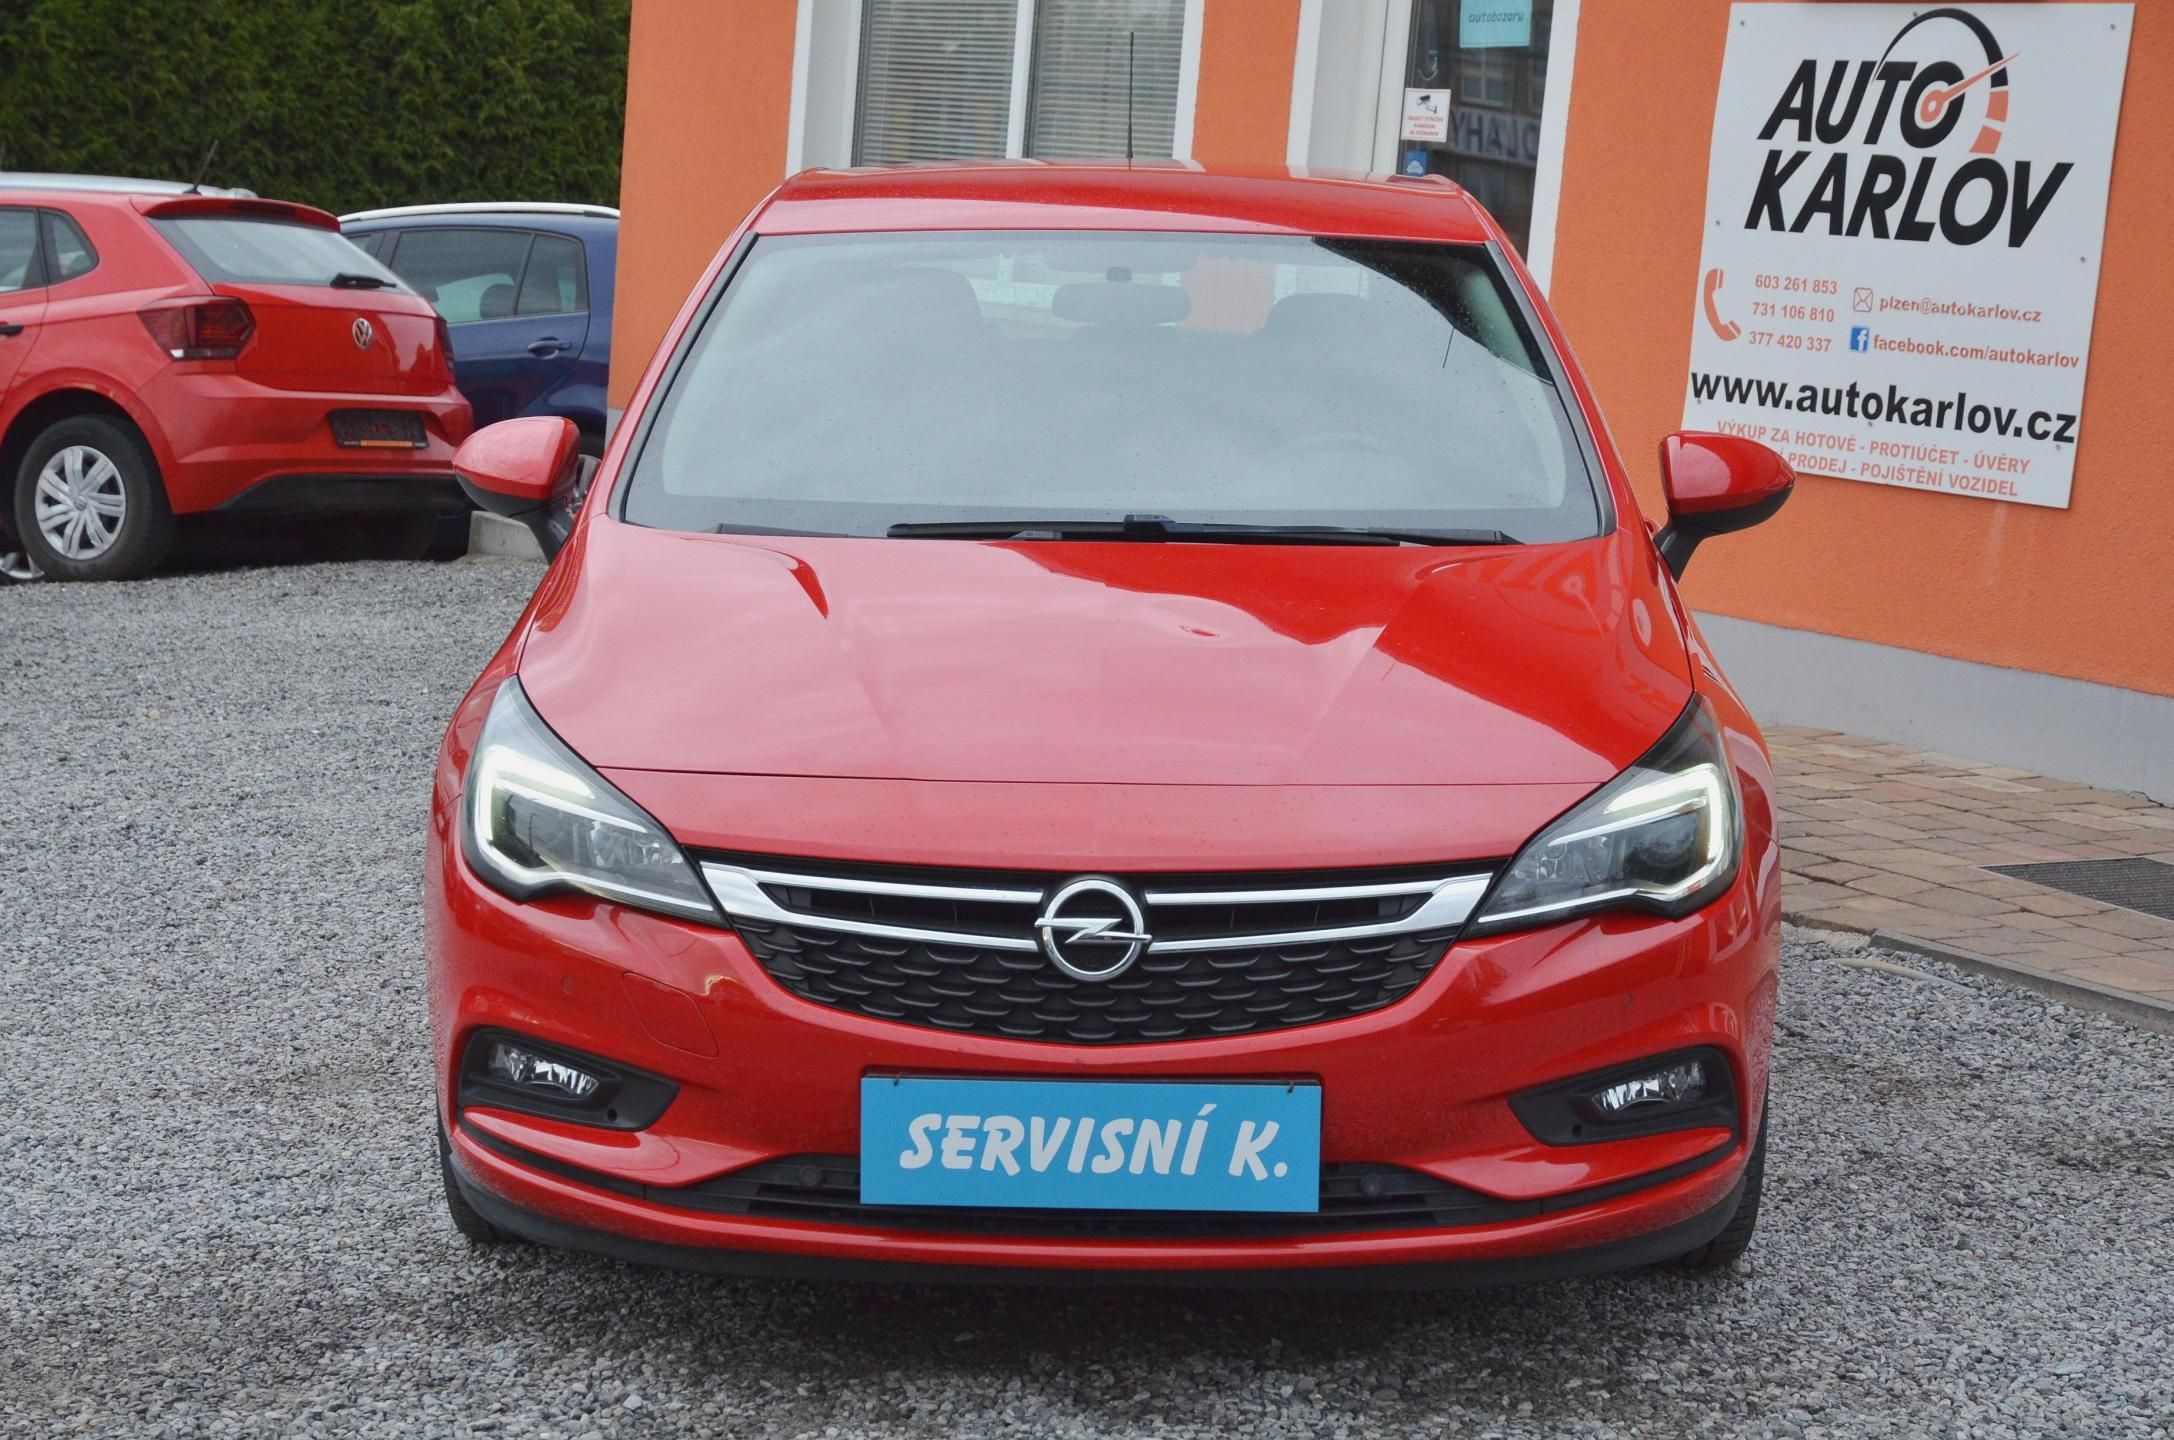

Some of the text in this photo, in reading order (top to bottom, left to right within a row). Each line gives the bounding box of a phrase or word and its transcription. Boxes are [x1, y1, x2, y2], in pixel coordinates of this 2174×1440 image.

[1756, 59, 1966, 149] AUTO
[1743, 149, 2075, 248] KARLOV
[1755, 274, 1837, 294] 603 261 853
[1752, 302, 1834, 322] 731 106 810
[1879, 296, 2041, 322] plzen@autokarlov.cz
[1749, 331, 1832, 352] 377 420 337
[1873, 335, 2080, 368] facebook.com/autokarlov
[1690, 372, 2077, 444] www.autokarlov.cz
[1717, 419, 1767, 440] VÝKUP
[1770, 427, 1790, 444] ZA
[1795, 431, 1857, 452] HOTOVÉ
[1869, 440, 1960, 465] PROTIÚČET
[1973, 450, 2031, 474] ÚVĚRY
[1788, 452, 1848, 473] PRODEJ
[1860, 462, 1944, 487] POJIŠTĚNÍ
[1949, 473, 2018, 497] VOZIDEL
[899, 1103, 1288, 1181] SERVISNÍ K.
